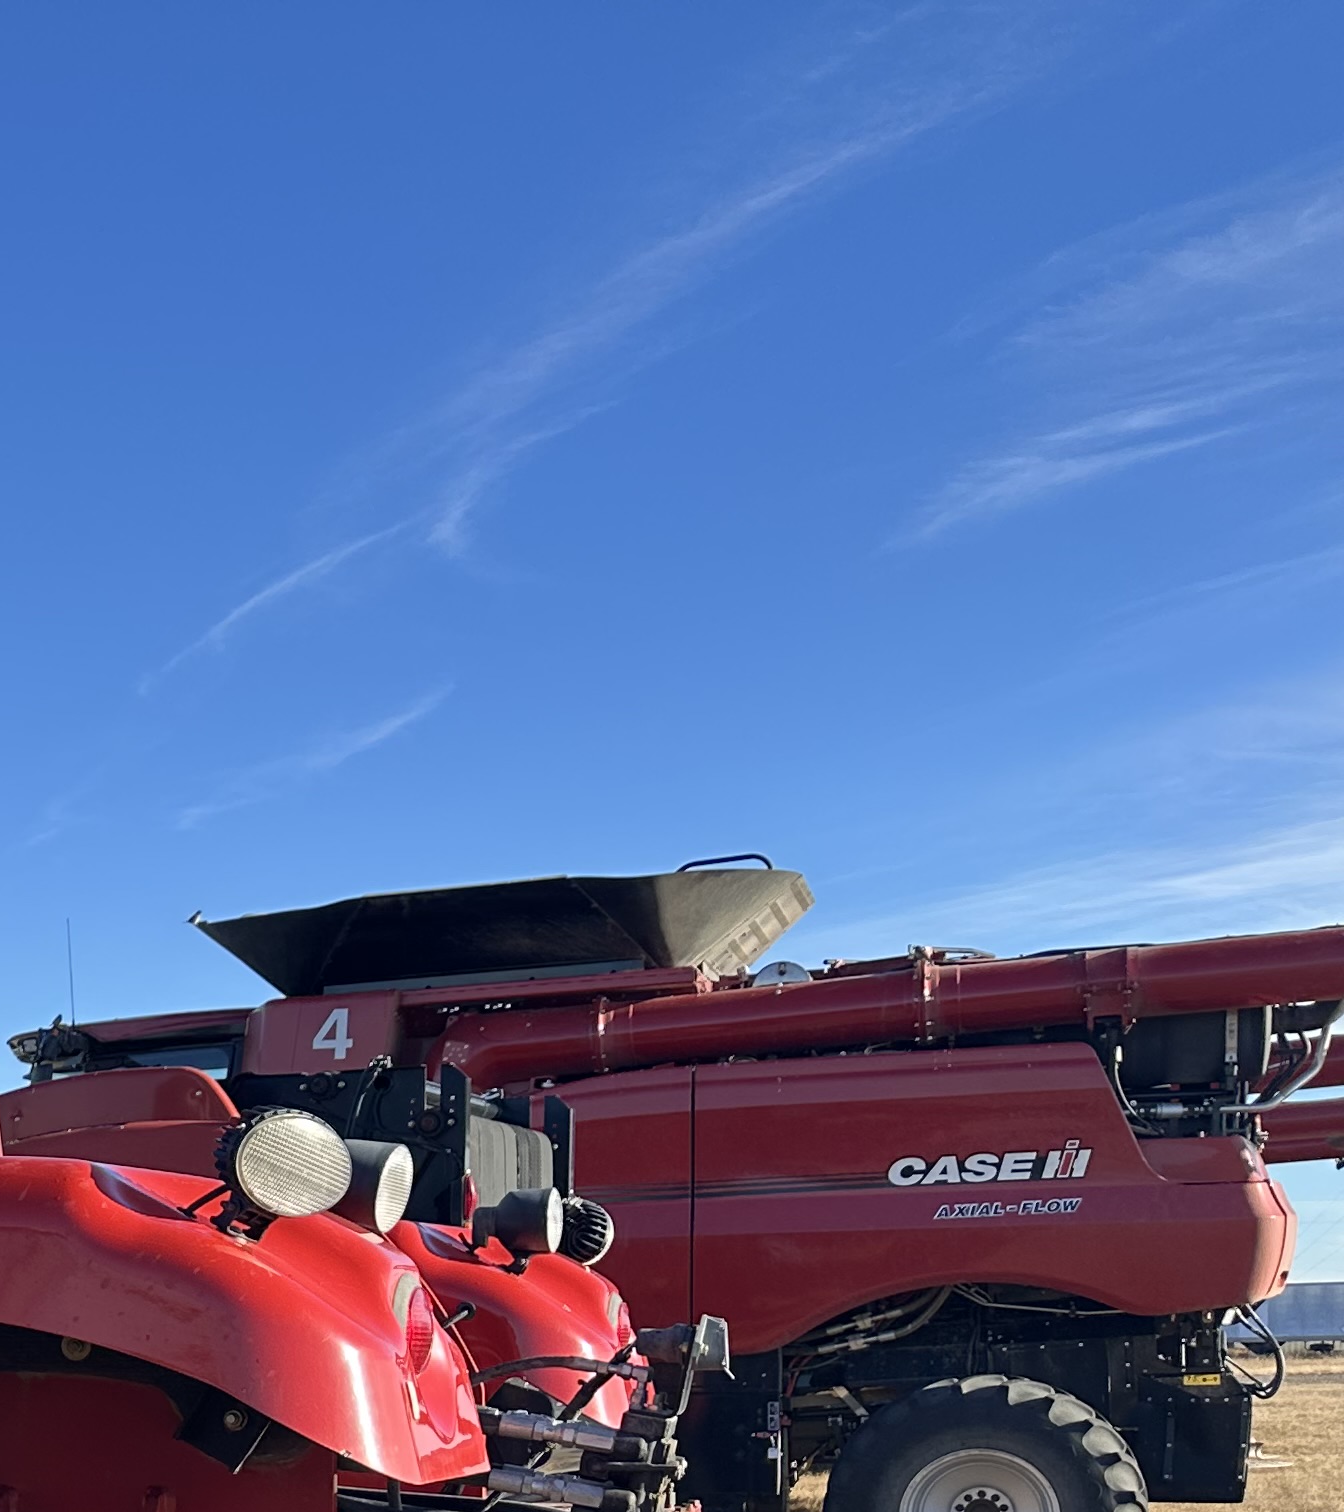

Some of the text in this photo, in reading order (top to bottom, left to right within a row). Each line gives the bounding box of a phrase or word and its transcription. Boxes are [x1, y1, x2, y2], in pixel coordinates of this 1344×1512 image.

[312, 1007, 354, 1060] 4
[887, 1151, 1038, 1187] CASE
[933, 1197, 1083, 1220] AXIAL-FLOW
